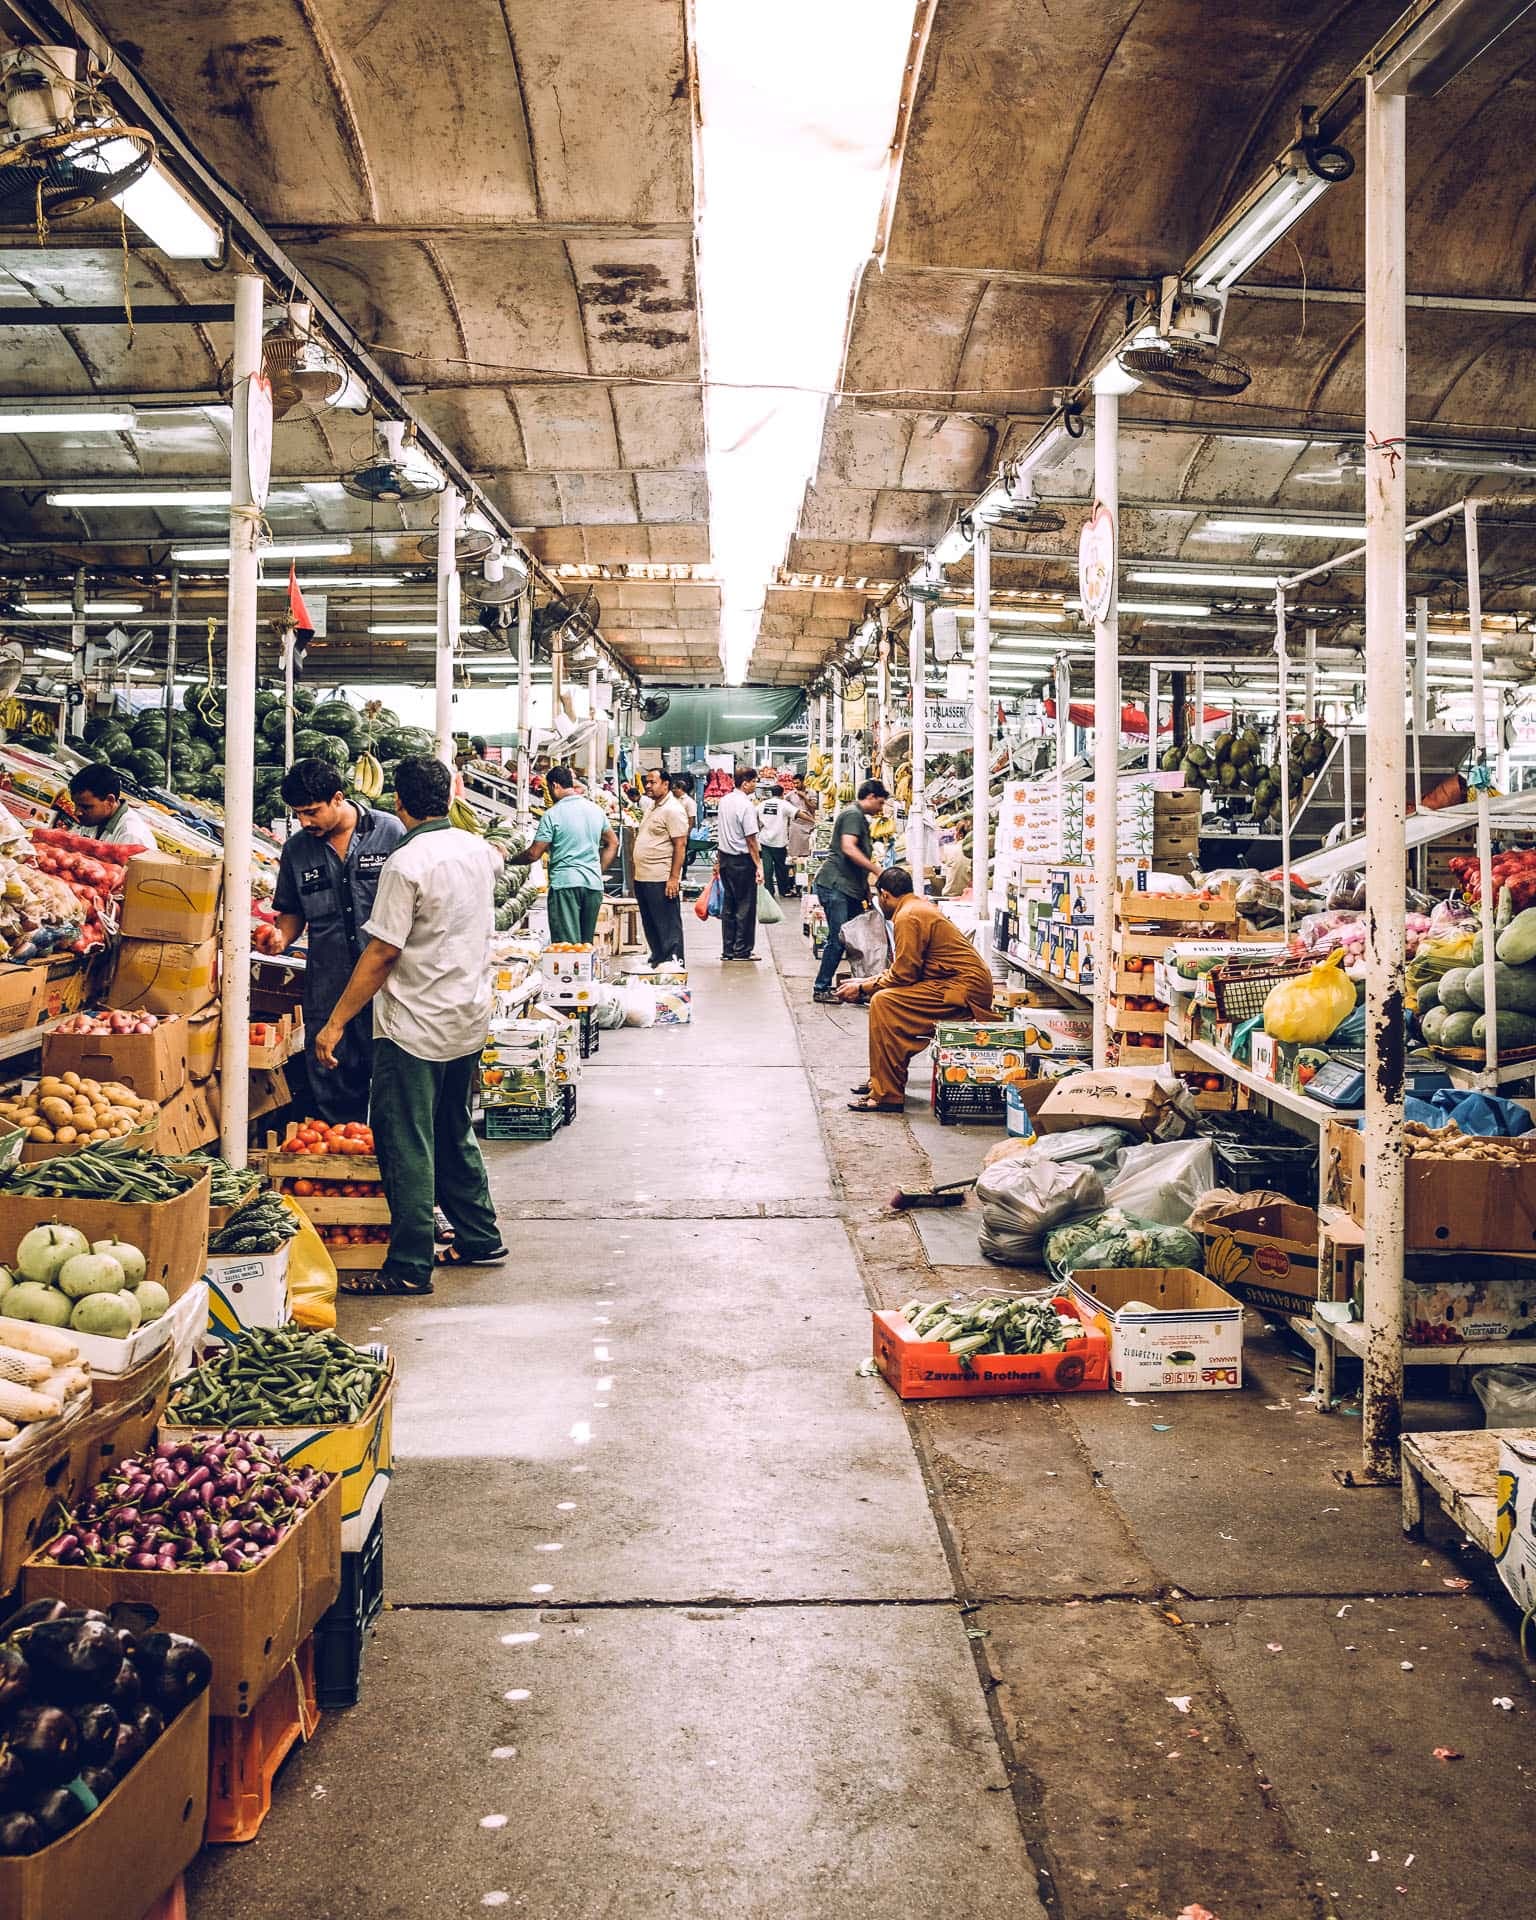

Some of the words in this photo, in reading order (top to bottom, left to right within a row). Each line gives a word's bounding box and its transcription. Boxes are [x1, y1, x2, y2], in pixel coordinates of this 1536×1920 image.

[1462, 1324, 1508, 1336] VEGETABLES
[983, 1370, 1042, 1381] Brothers
[1201, 1368, 1238, 1385] Dole
